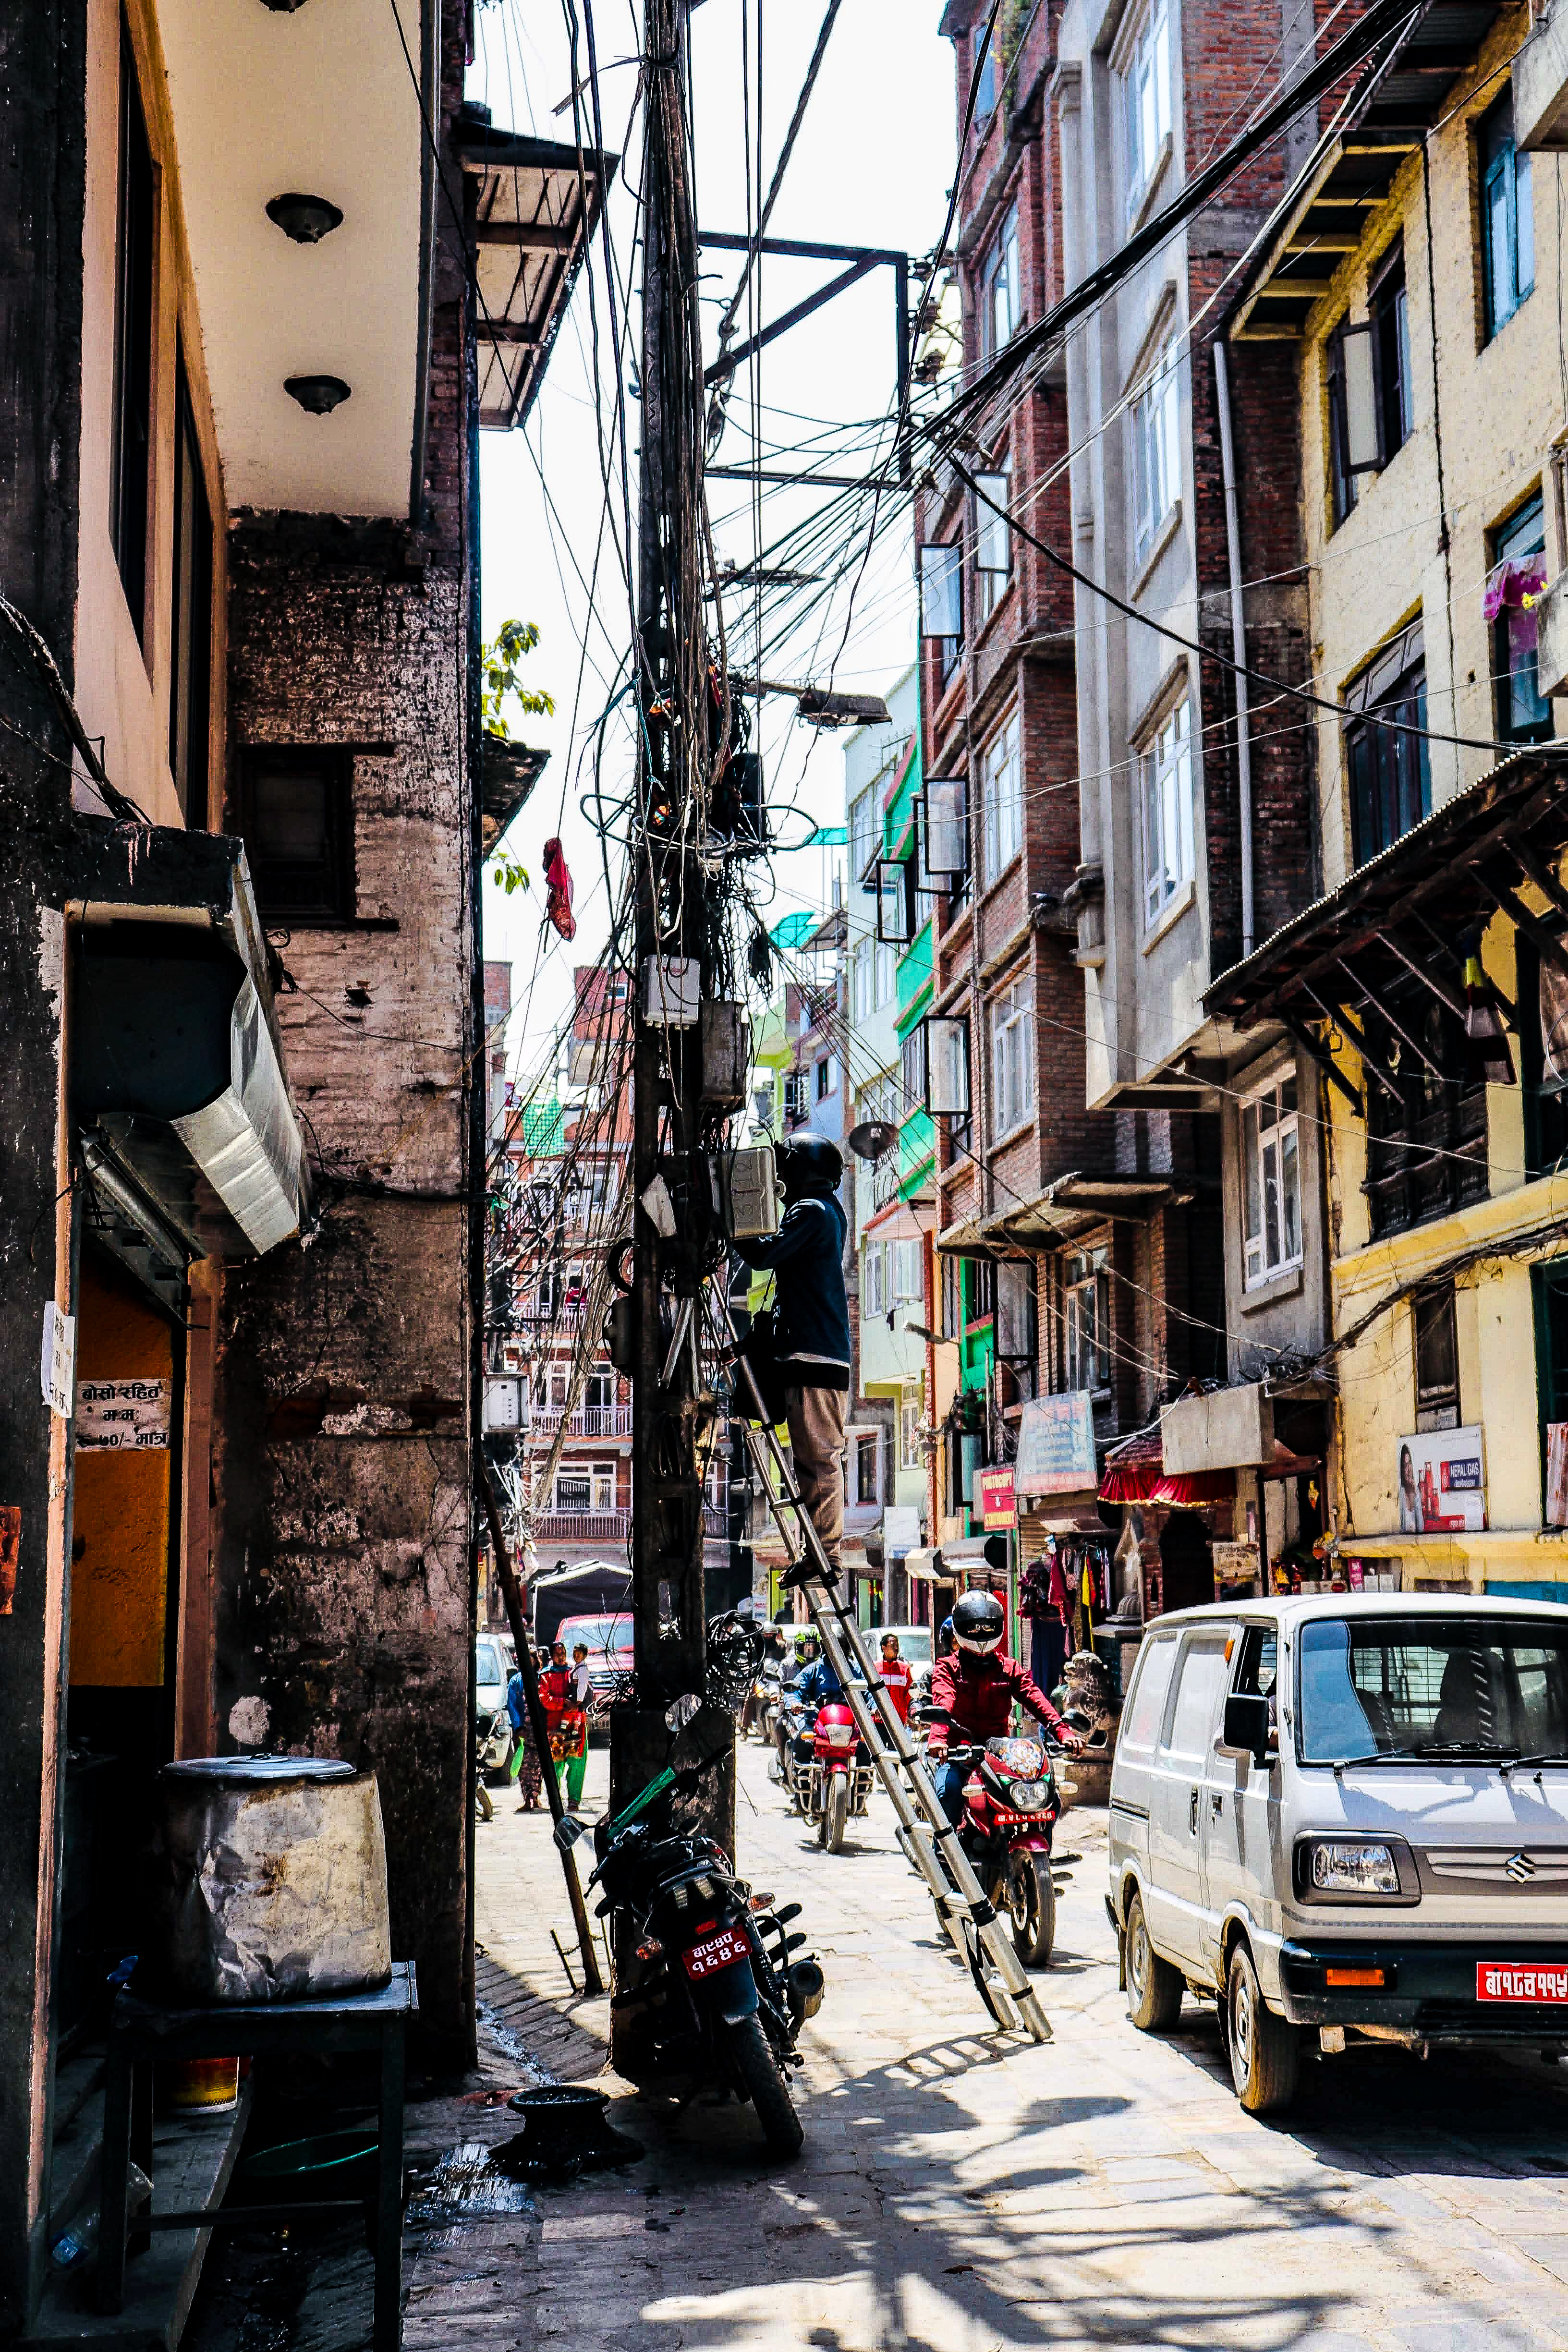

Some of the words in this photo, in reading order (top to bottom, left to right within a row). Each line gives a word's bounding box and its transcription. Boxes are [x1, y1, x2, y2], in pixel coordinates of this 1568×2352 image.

[82, 1383, 116, 1400] बोसो
[118, 1382, 160, 1400] रहित
[135, 1430, 168, 1445] मात्र
[1450, 1464, 1467, 1478] NEPAL
[1467, 1462, 1479, 1476] GAS
